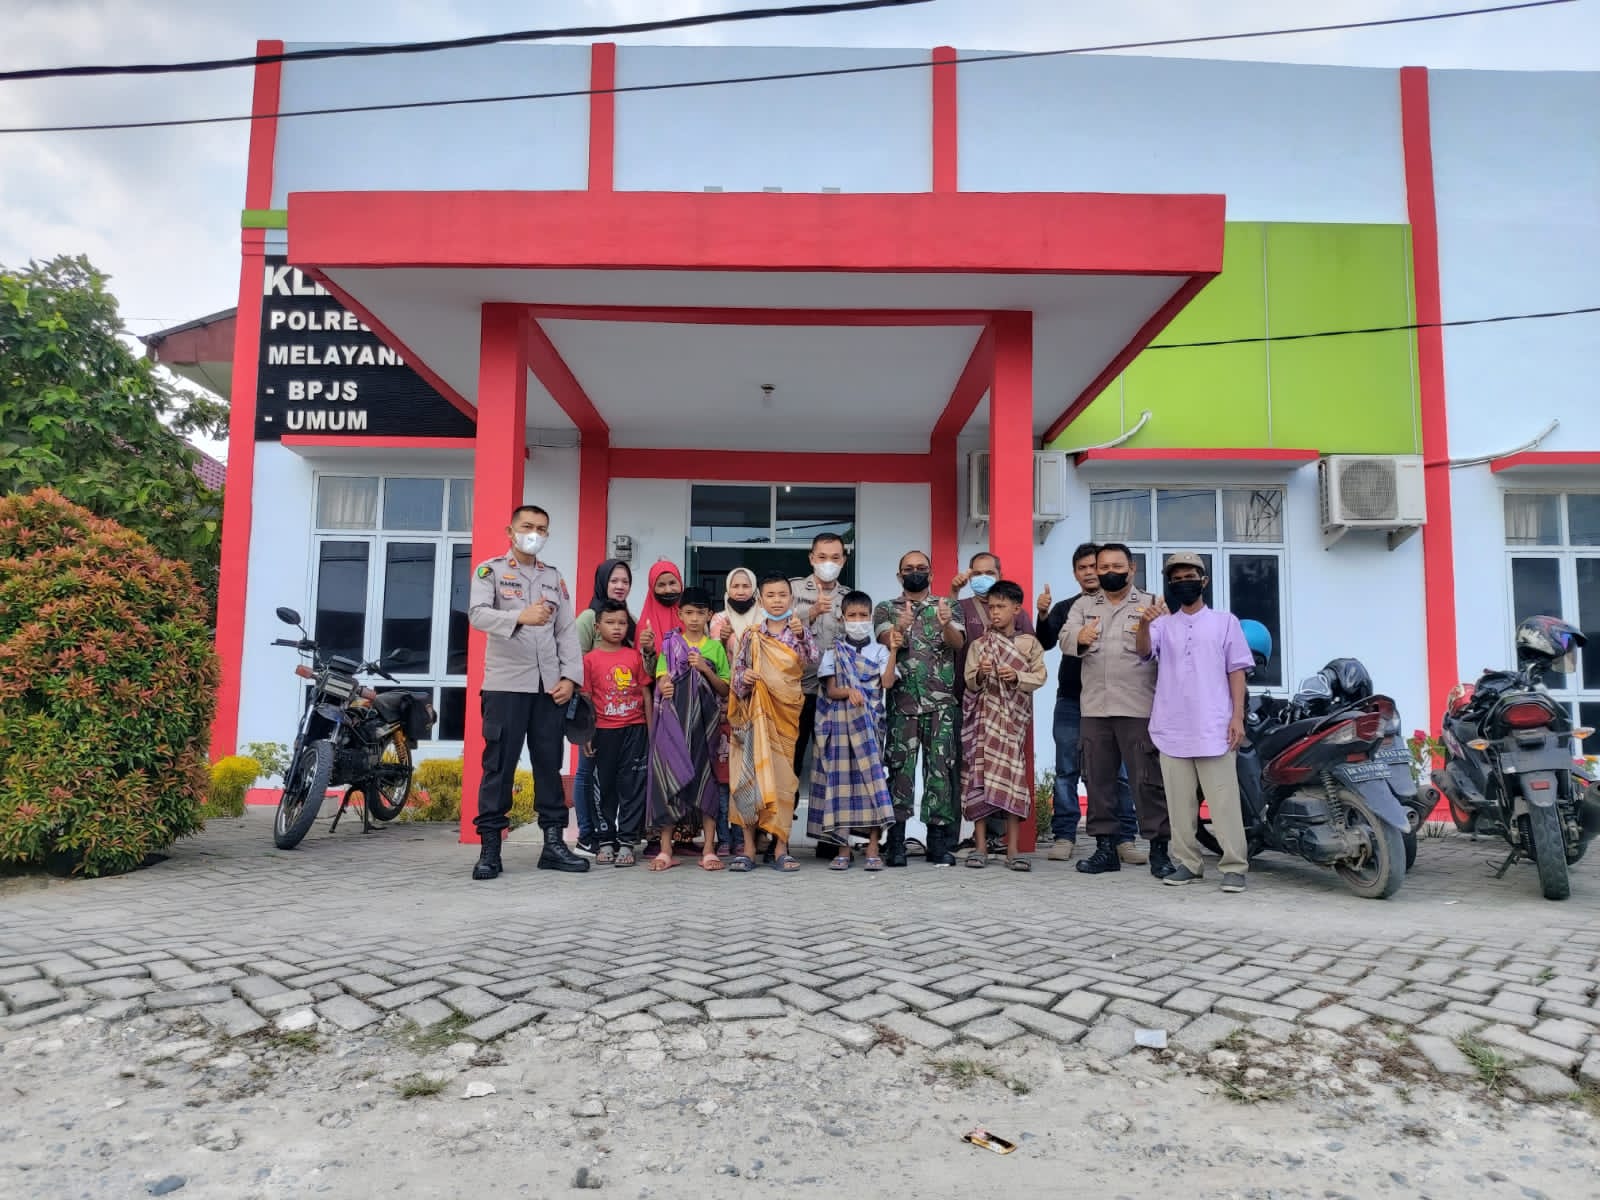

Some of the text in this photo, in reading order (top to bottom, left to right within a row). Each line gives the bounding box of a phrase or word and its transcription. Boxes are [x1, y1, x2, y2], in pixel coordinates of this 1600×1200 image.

[263, 266, 332, 296] KL
[288, 380, 358, 401] BPJS
[287, 410, 368, 431] UMUM
